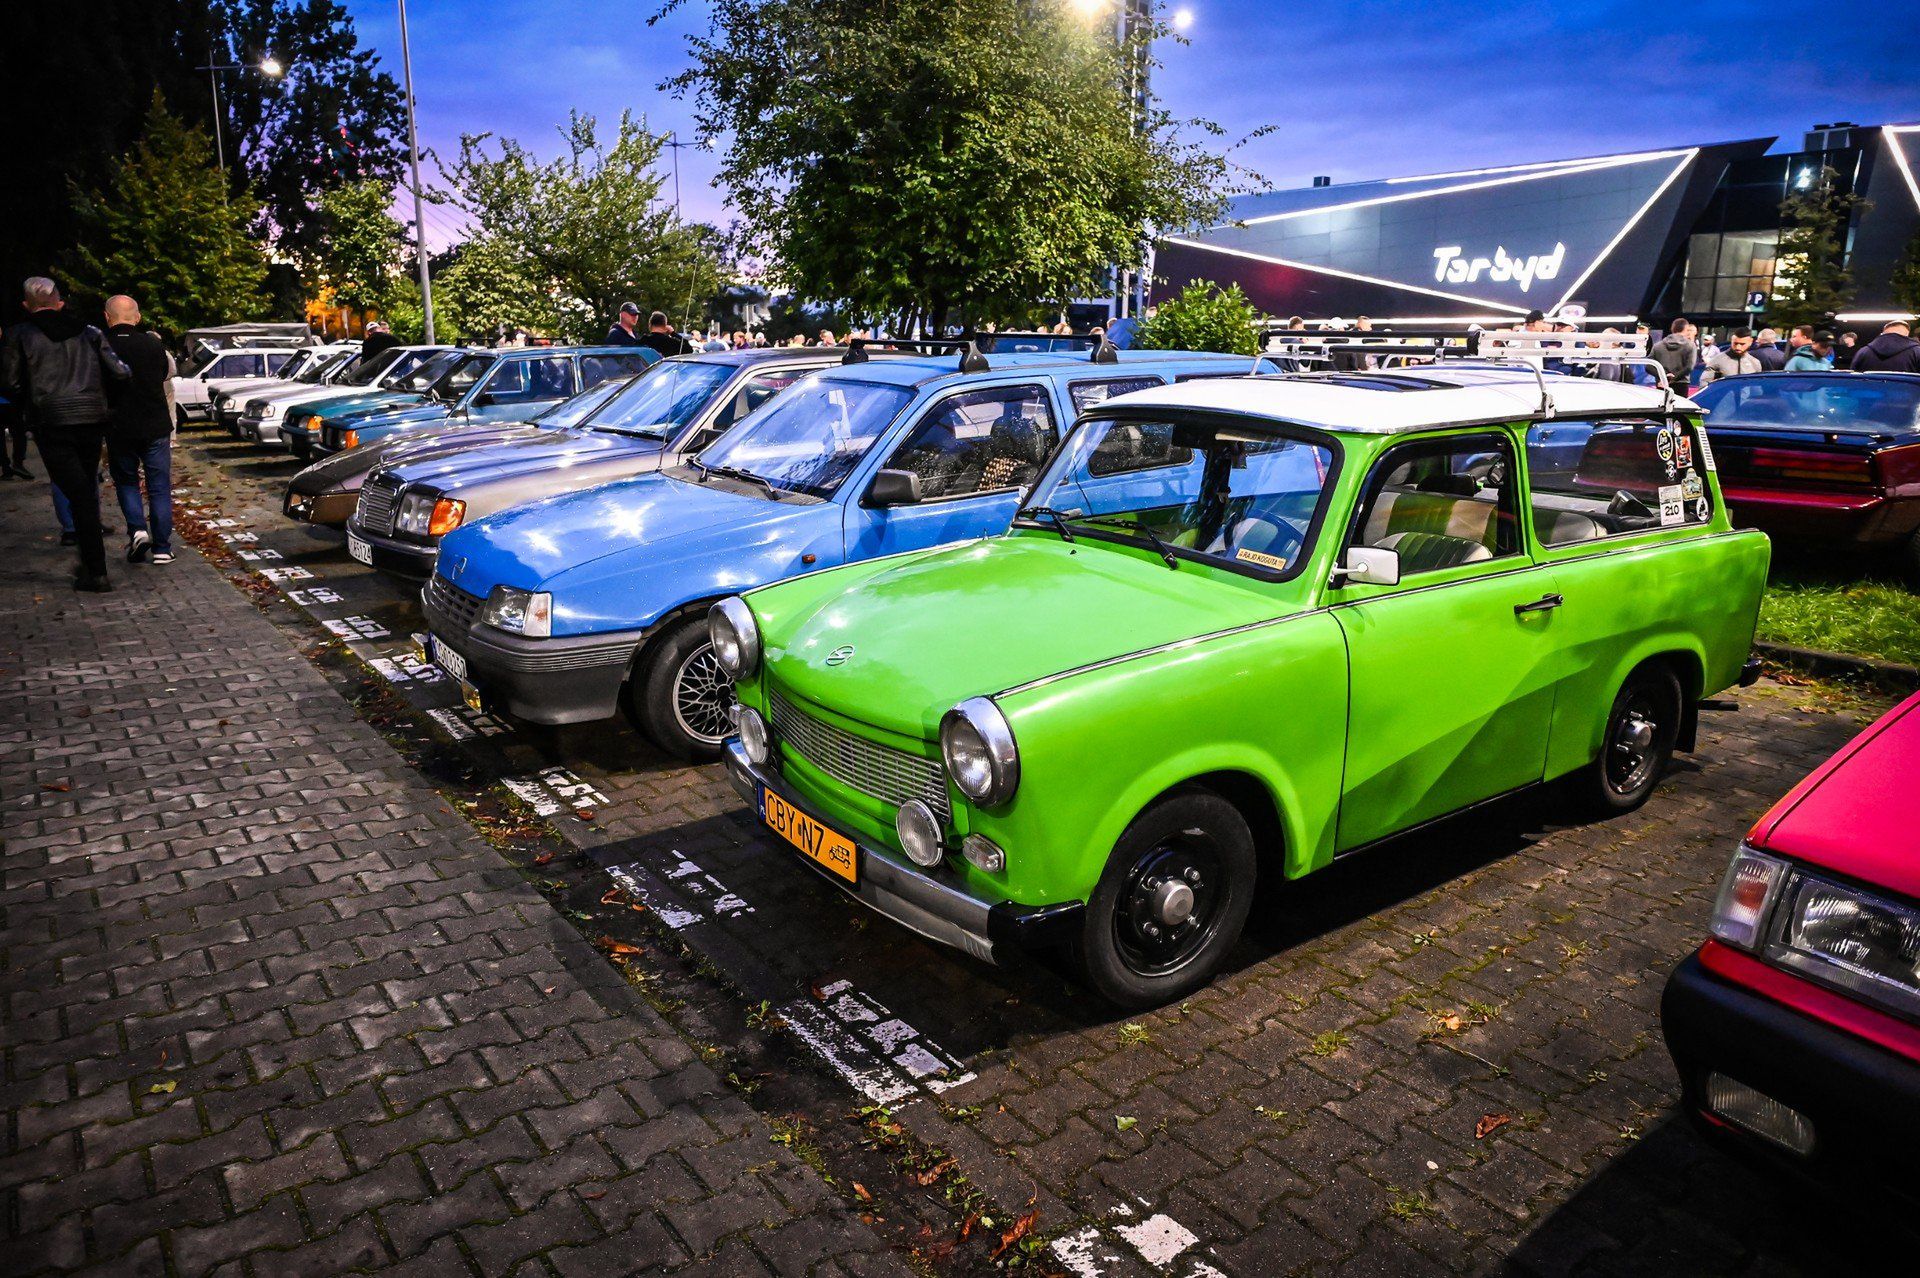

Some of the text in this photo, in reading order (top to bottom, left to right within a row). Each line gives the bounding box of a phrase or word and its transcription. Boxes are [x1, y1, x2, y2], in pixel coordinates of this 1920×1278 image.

[1433, 241, 1566, 293] Torbyd
[1754, 293, 1763, 305] P
[1664, 504, 1680, 516] 210
[767, 793, 825, 858] CBY N7
